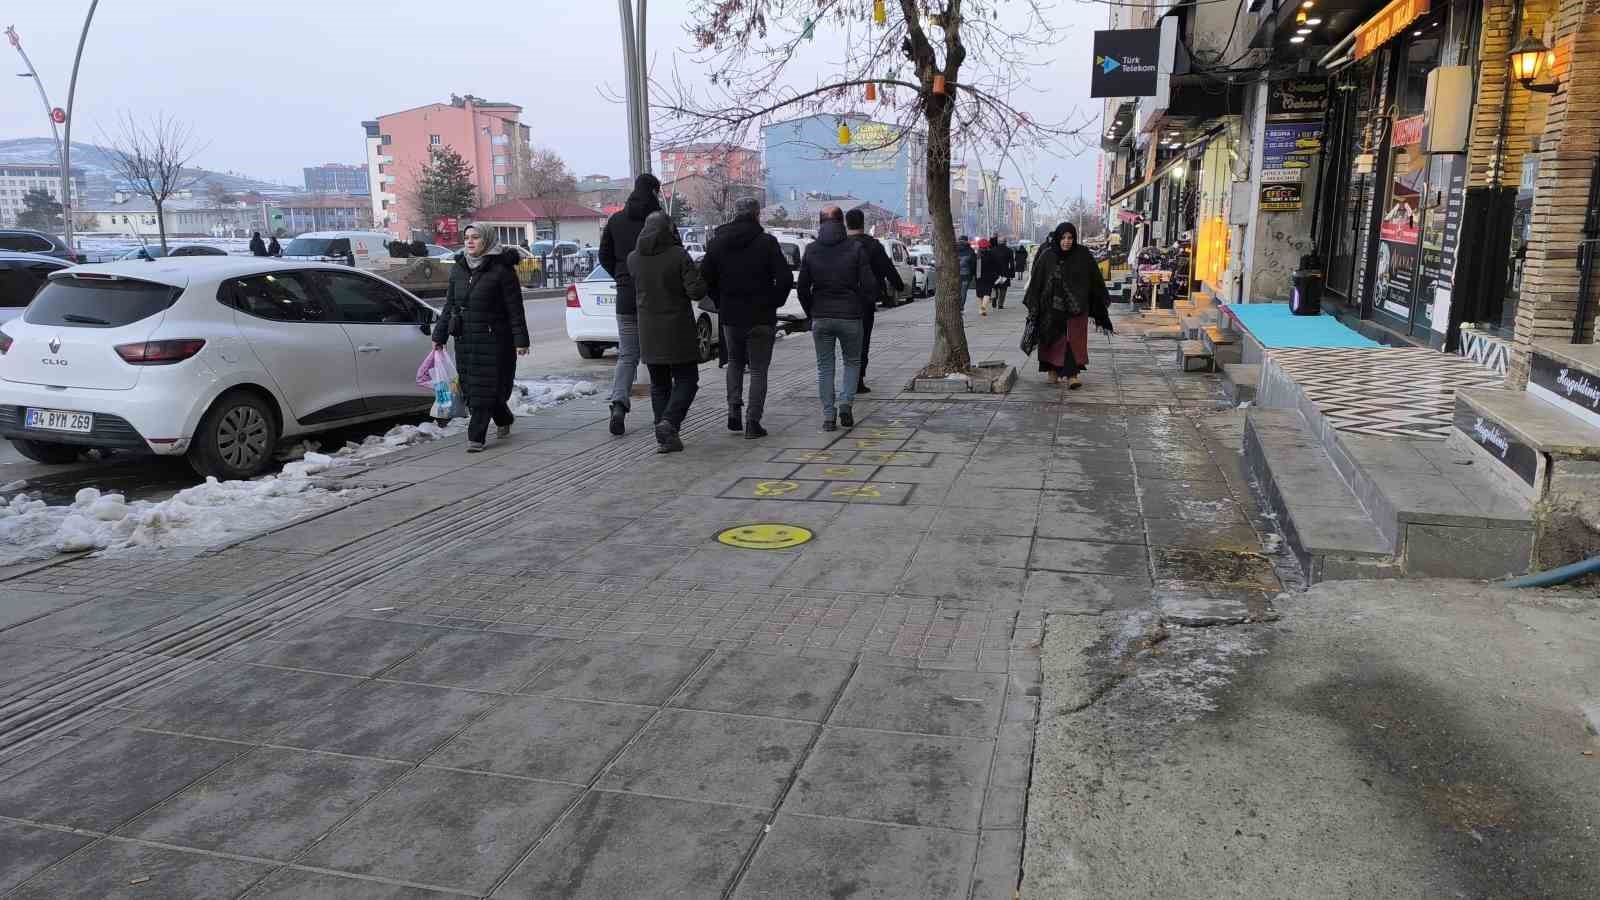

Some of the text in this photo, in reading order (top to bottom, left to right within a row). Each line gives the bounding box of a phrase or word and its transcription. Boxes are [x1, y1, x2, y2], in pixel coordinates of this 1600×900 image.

[1121, 56, 1140, 64] Türk
[1122, 64, 1156, 72] Telekom
[41, 358, 68, 366] CLIO
[33, 411, 90, 429] 34 BYM 269
